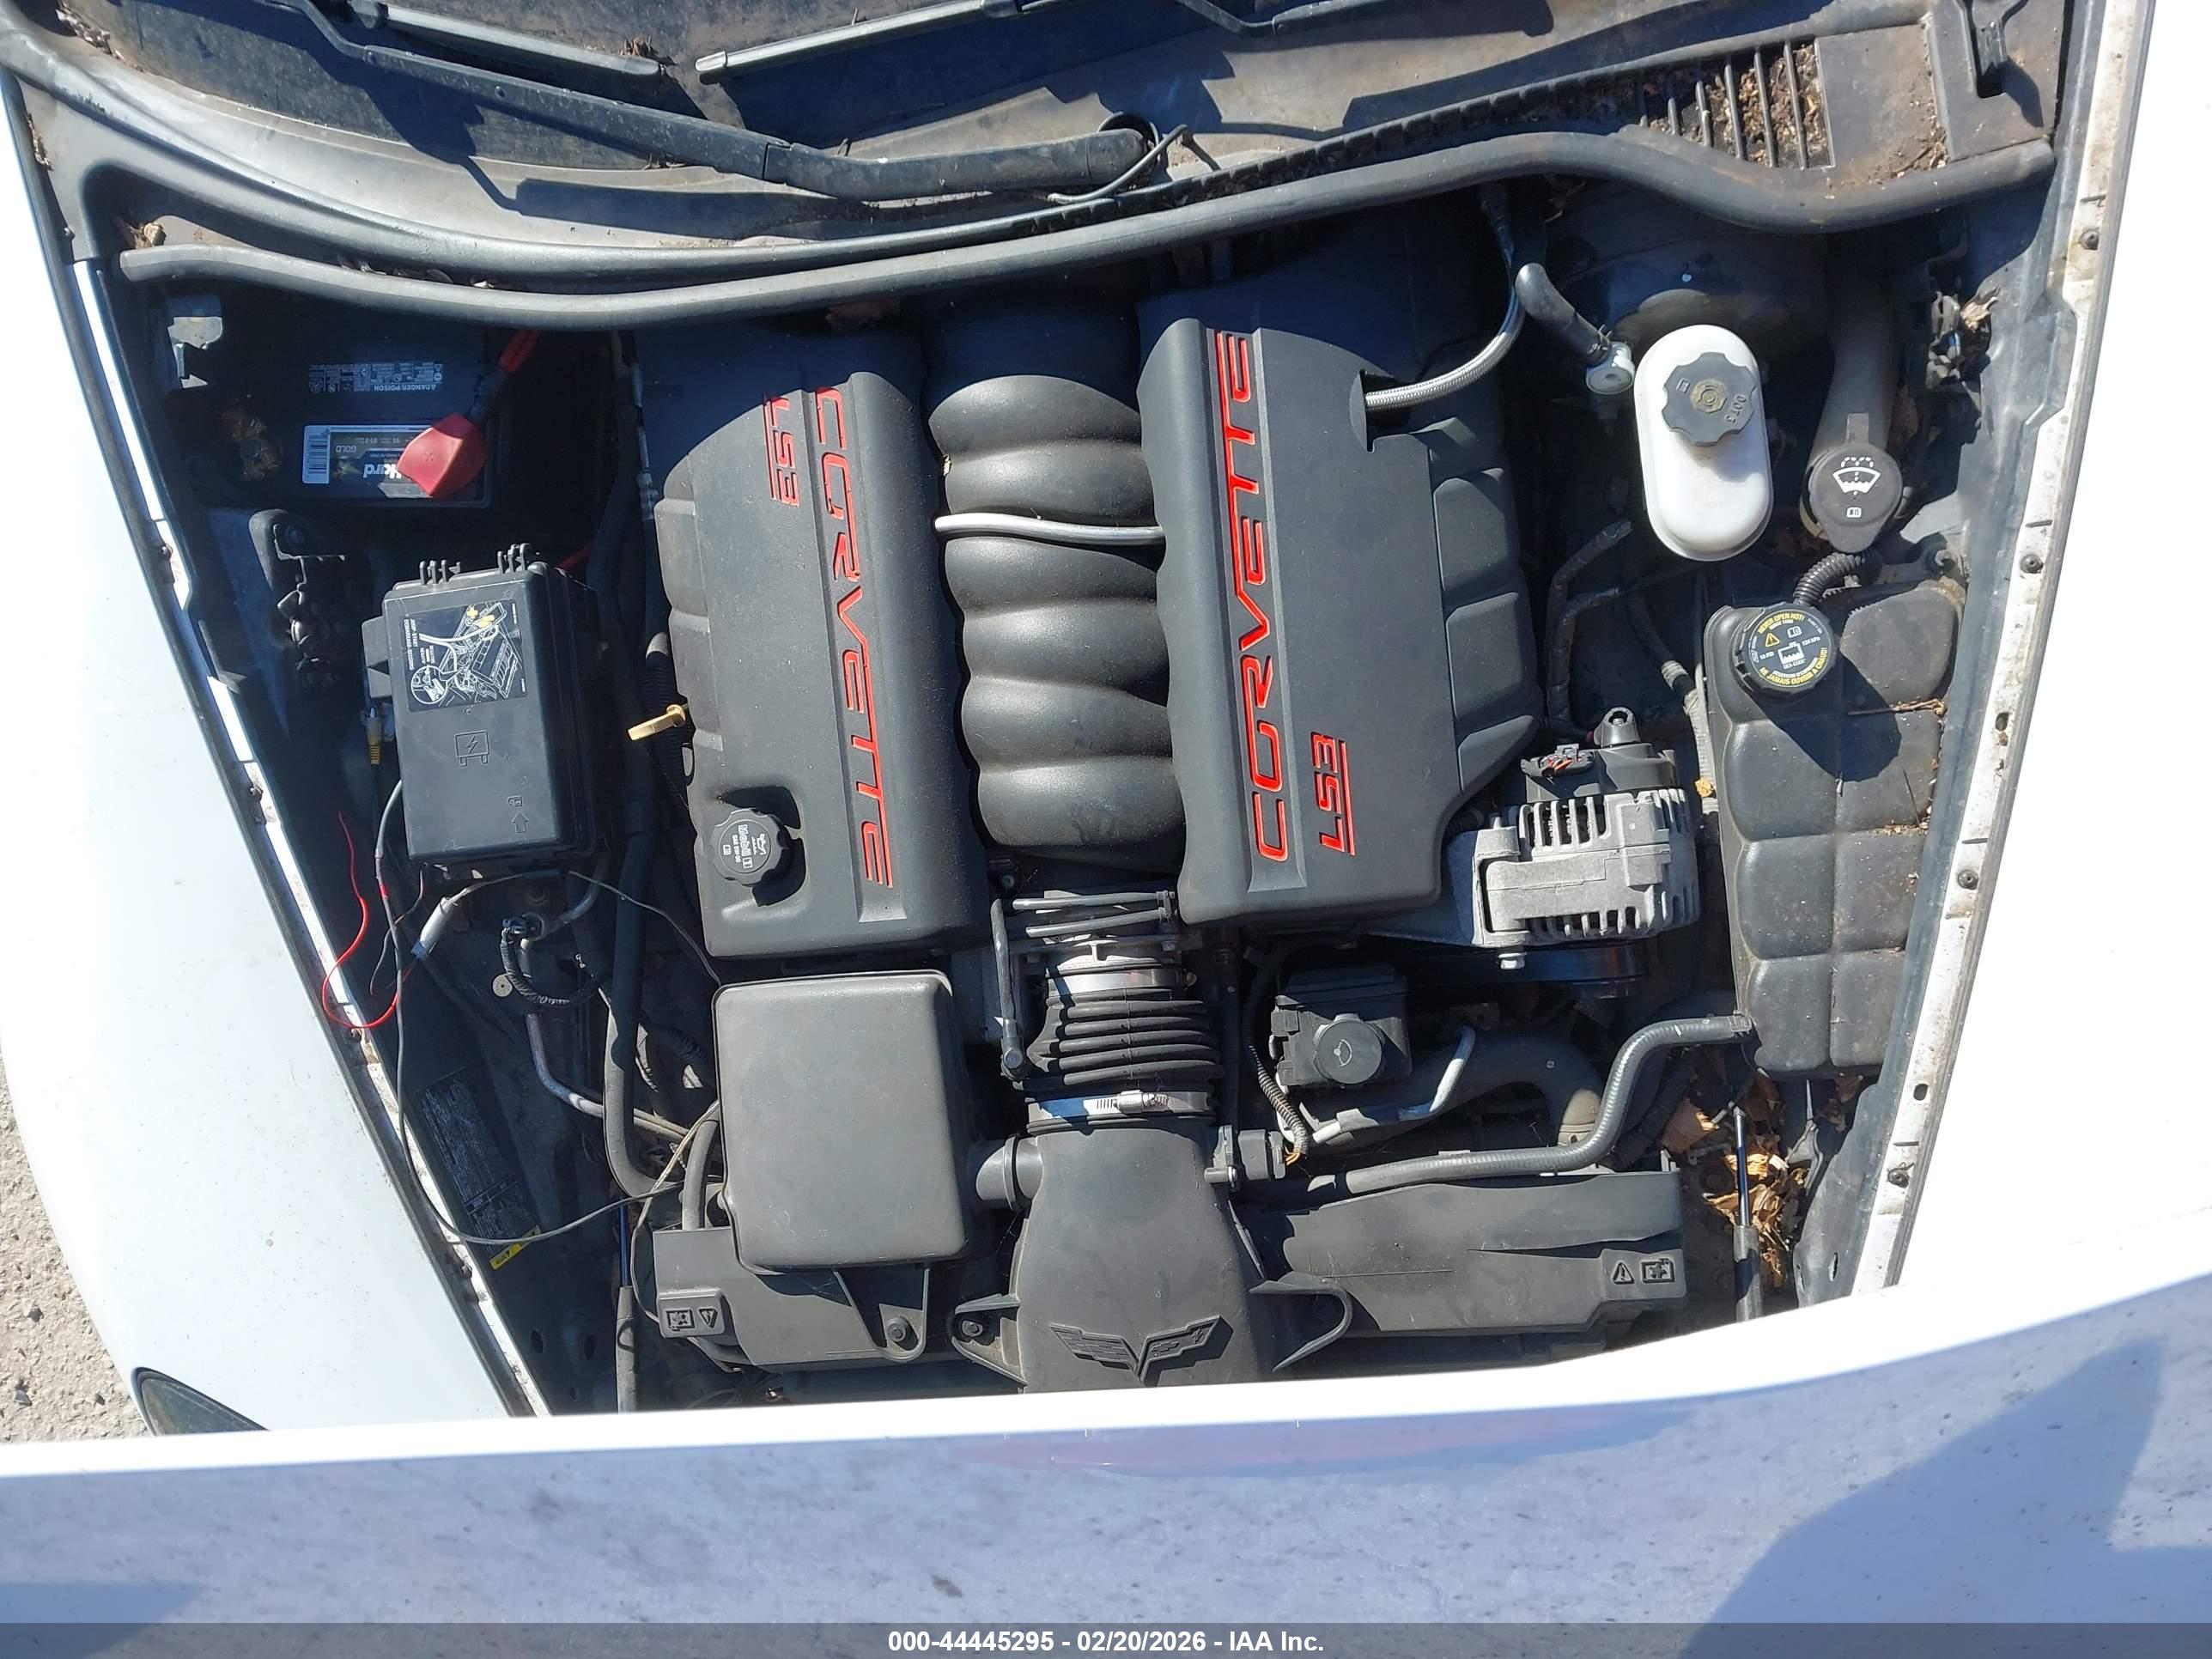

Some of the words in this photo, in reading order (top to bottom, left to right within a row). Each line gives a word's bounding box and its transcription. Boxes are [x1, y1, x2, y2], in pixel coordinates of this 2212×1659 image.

[1731, 395, 1747, 416] DOT
[336, 445, 356, 453] GOLD
[772, 394, 801, 507] LS3
[362, 464, 402, 478] Hard
[1216, 331, 1290, 861] CORVETTE
[817, 386, 894, 888] CORVETTE
[1758, 618, 1774, 634] NEVER
[1790, 613, 1805, 622] HOT!
[1766, 673, 1790, 684] JAMAIS
[1791, 672, 1814, 684] OUVRIR
[1815, 647, 1827, 669] CHAUD!
[1311, 732, 1348, 853] LS3
[738, 824, 751, 856] Mobil
